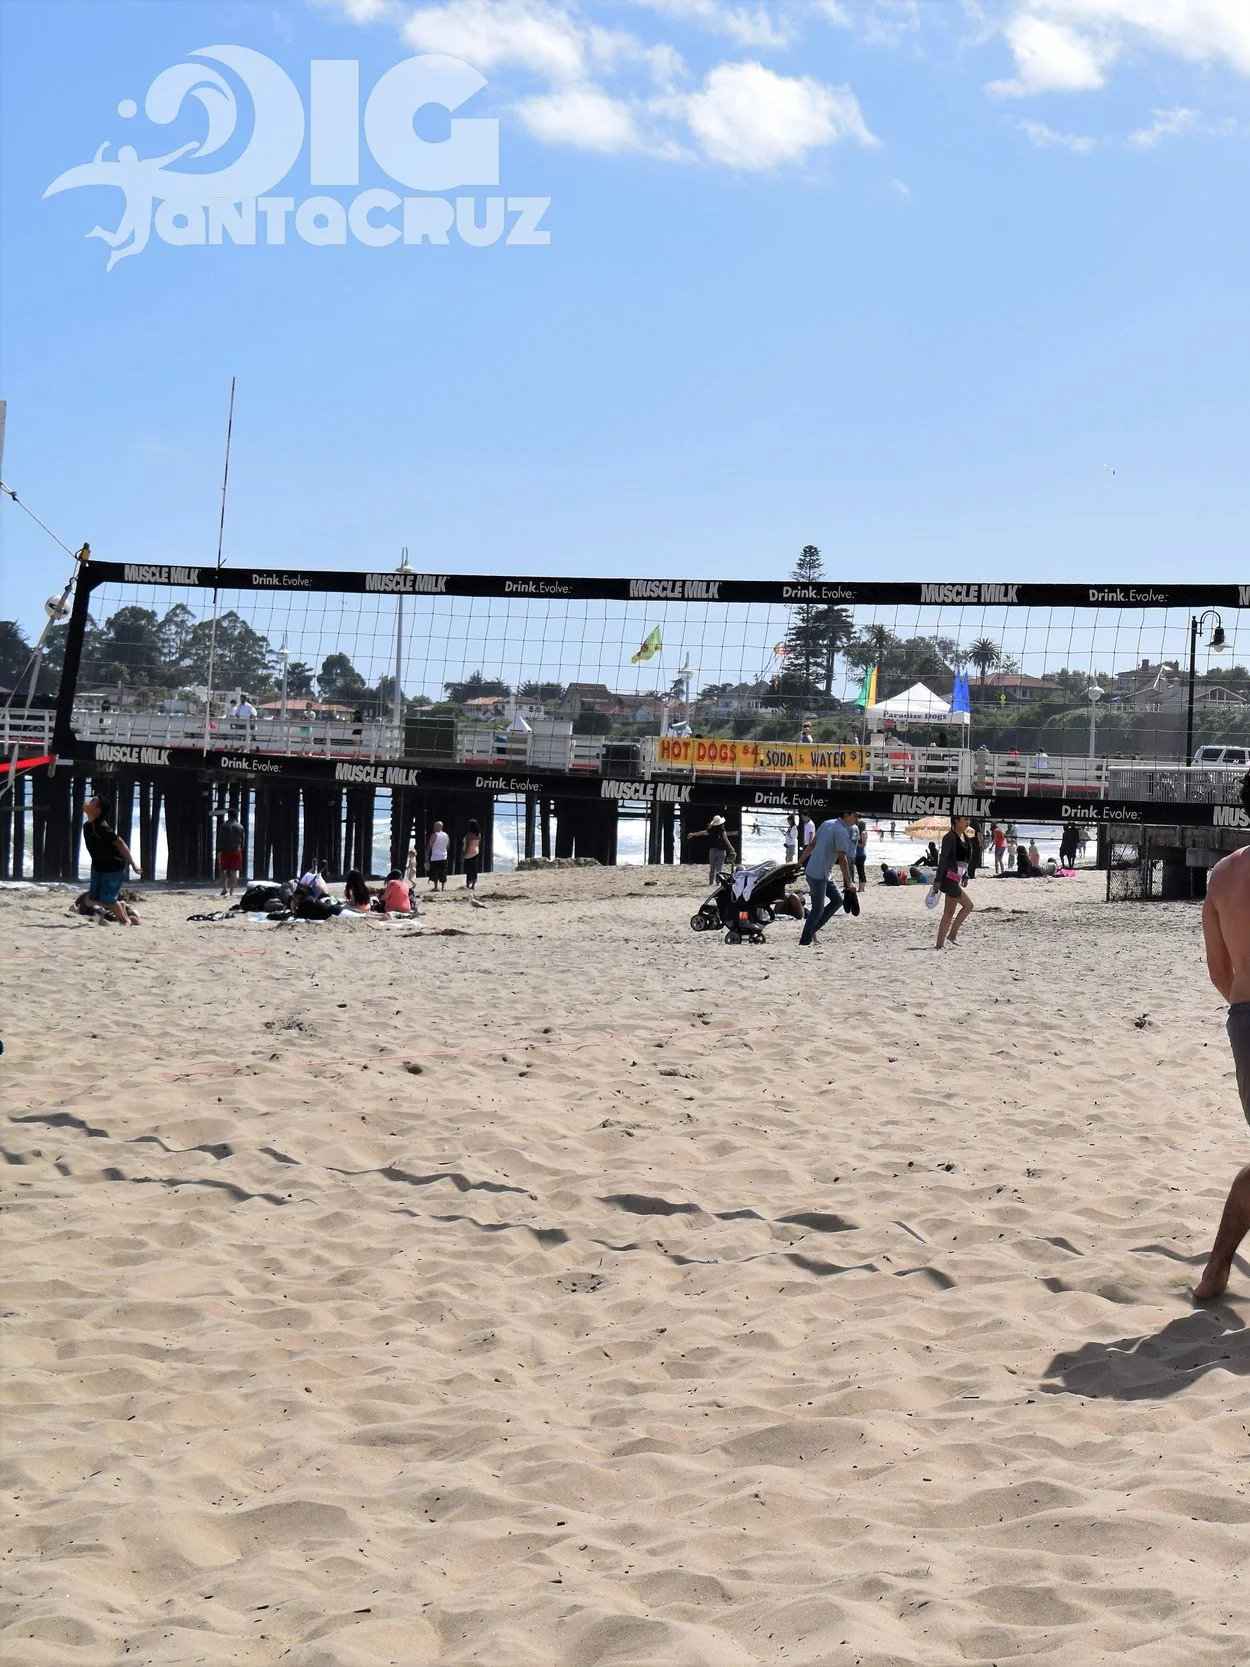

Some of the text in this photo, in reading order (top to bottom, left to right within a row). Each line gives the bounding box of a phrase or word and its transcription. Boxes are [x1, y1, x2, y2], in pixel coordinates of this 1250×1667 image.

[124, 564, 199, 585] MUSCLE MILK
[366, 574, 446, 592] MUSCLE MILK
[629, 580, 719, 599] MUSCLE MILK
[921, 584, 1018, 603] MUSCLE MILK
[883, 711, 947, 721] Paradise Dogs
[96, 743, 170, 766] MUSCLE MILK
[661, 740, 759, 765] HOT DOGS $4
[766, 750, 793, 767] SODA
[811, 750, 846, 767] WATER
[335, 763, 418, 786] MUSCLE MILK
[601, 780, 691, 802] MUSCLE MILK
[892, 795, 992, 816] MUSCLE MILK
